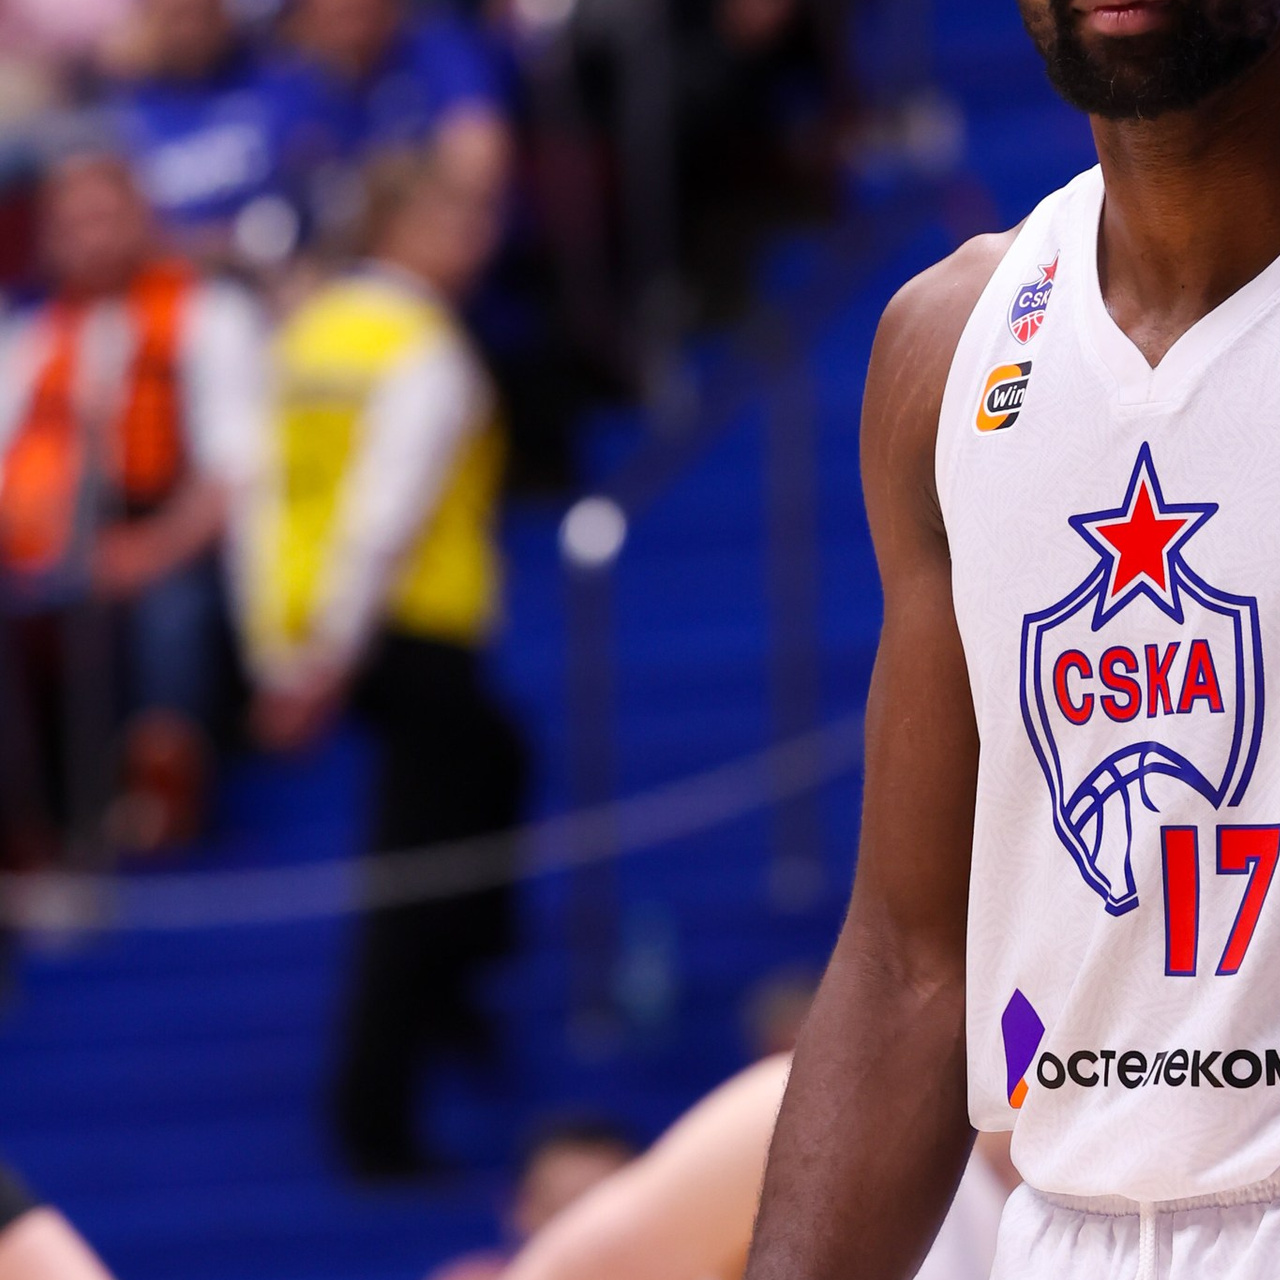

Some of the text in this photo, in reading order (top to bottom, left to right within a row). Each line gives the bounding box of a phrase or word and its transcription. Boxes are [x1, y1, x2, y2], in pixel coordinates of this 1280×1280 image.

[1019, 288, 1051, 308] CSK
[994, 386, 1026, 408] Win
[1053, 639, 1224, 726] CSKA
